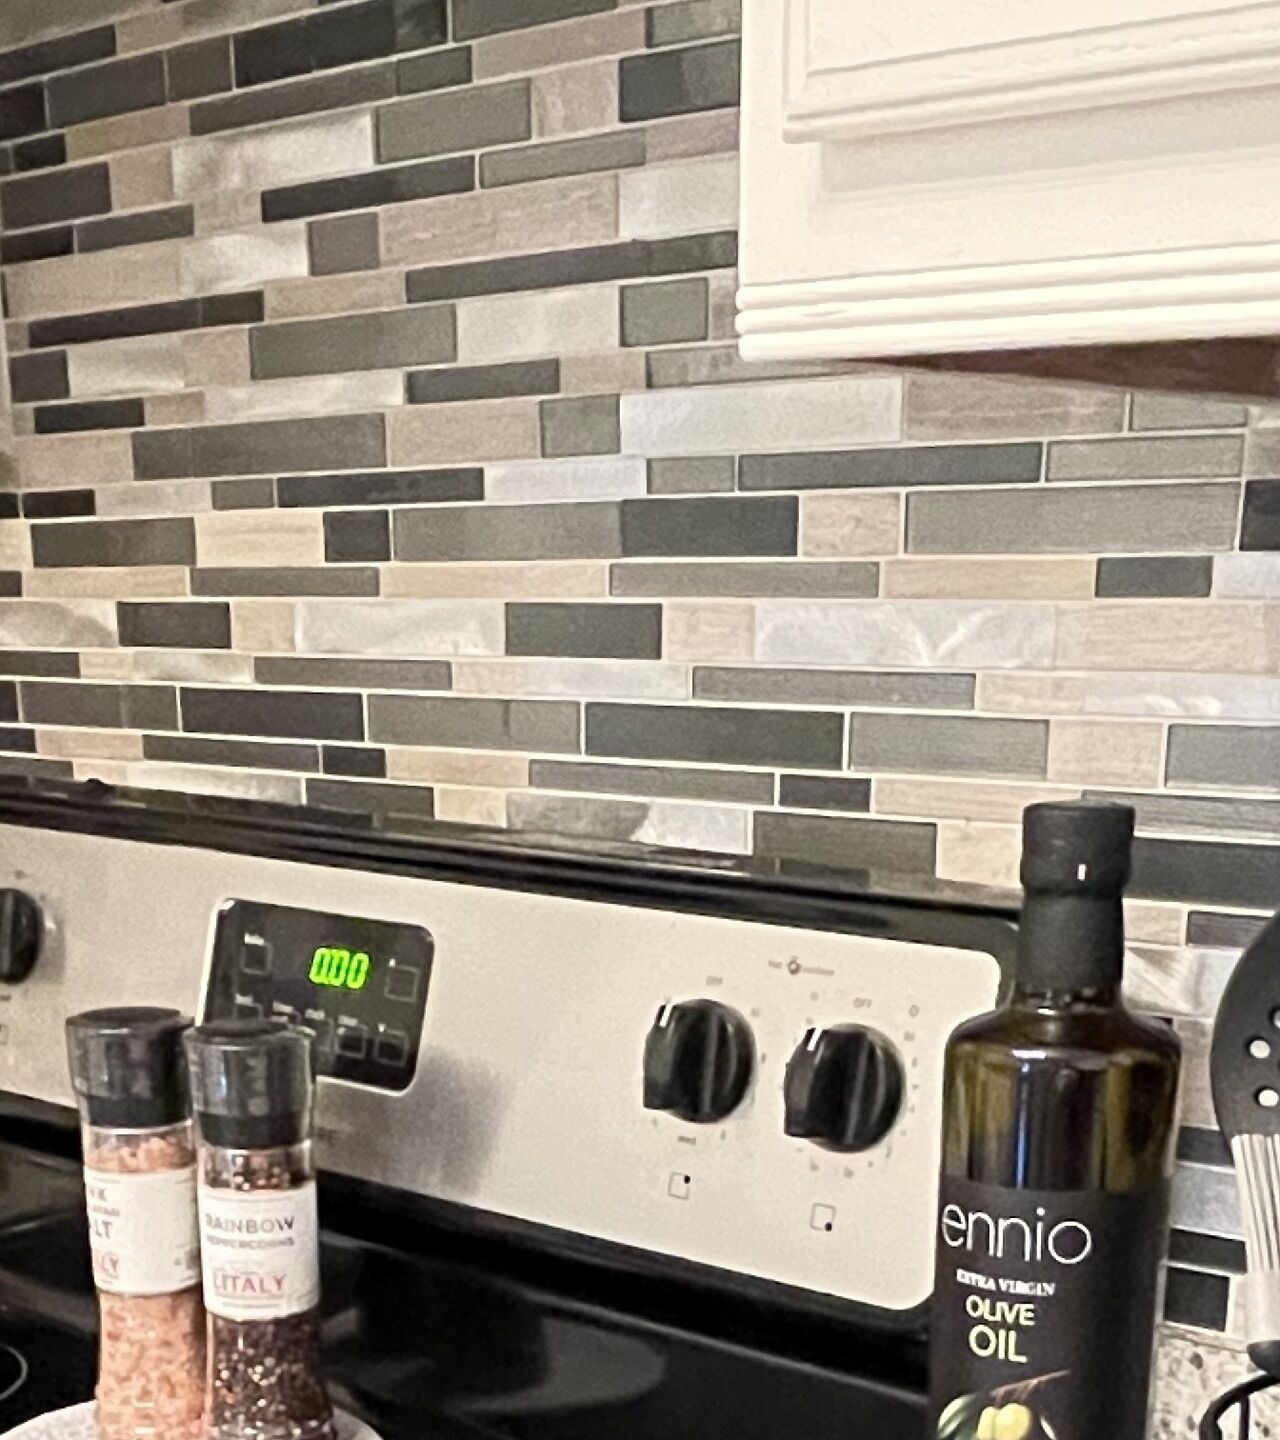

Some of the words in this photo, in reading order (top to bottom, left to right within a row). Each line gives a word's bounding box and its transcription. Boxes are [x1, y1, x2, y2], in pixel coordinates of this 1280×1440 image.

[204, 1213, 295, 1233] RAINBOW
[942, 1204, 1092, 1264] ennio
[998, 1277, 1056, 1296] VIRGIN
[966, 1294, 1035, 1325] OLIVE
[969, 1324, 1028, 1363] OIL
